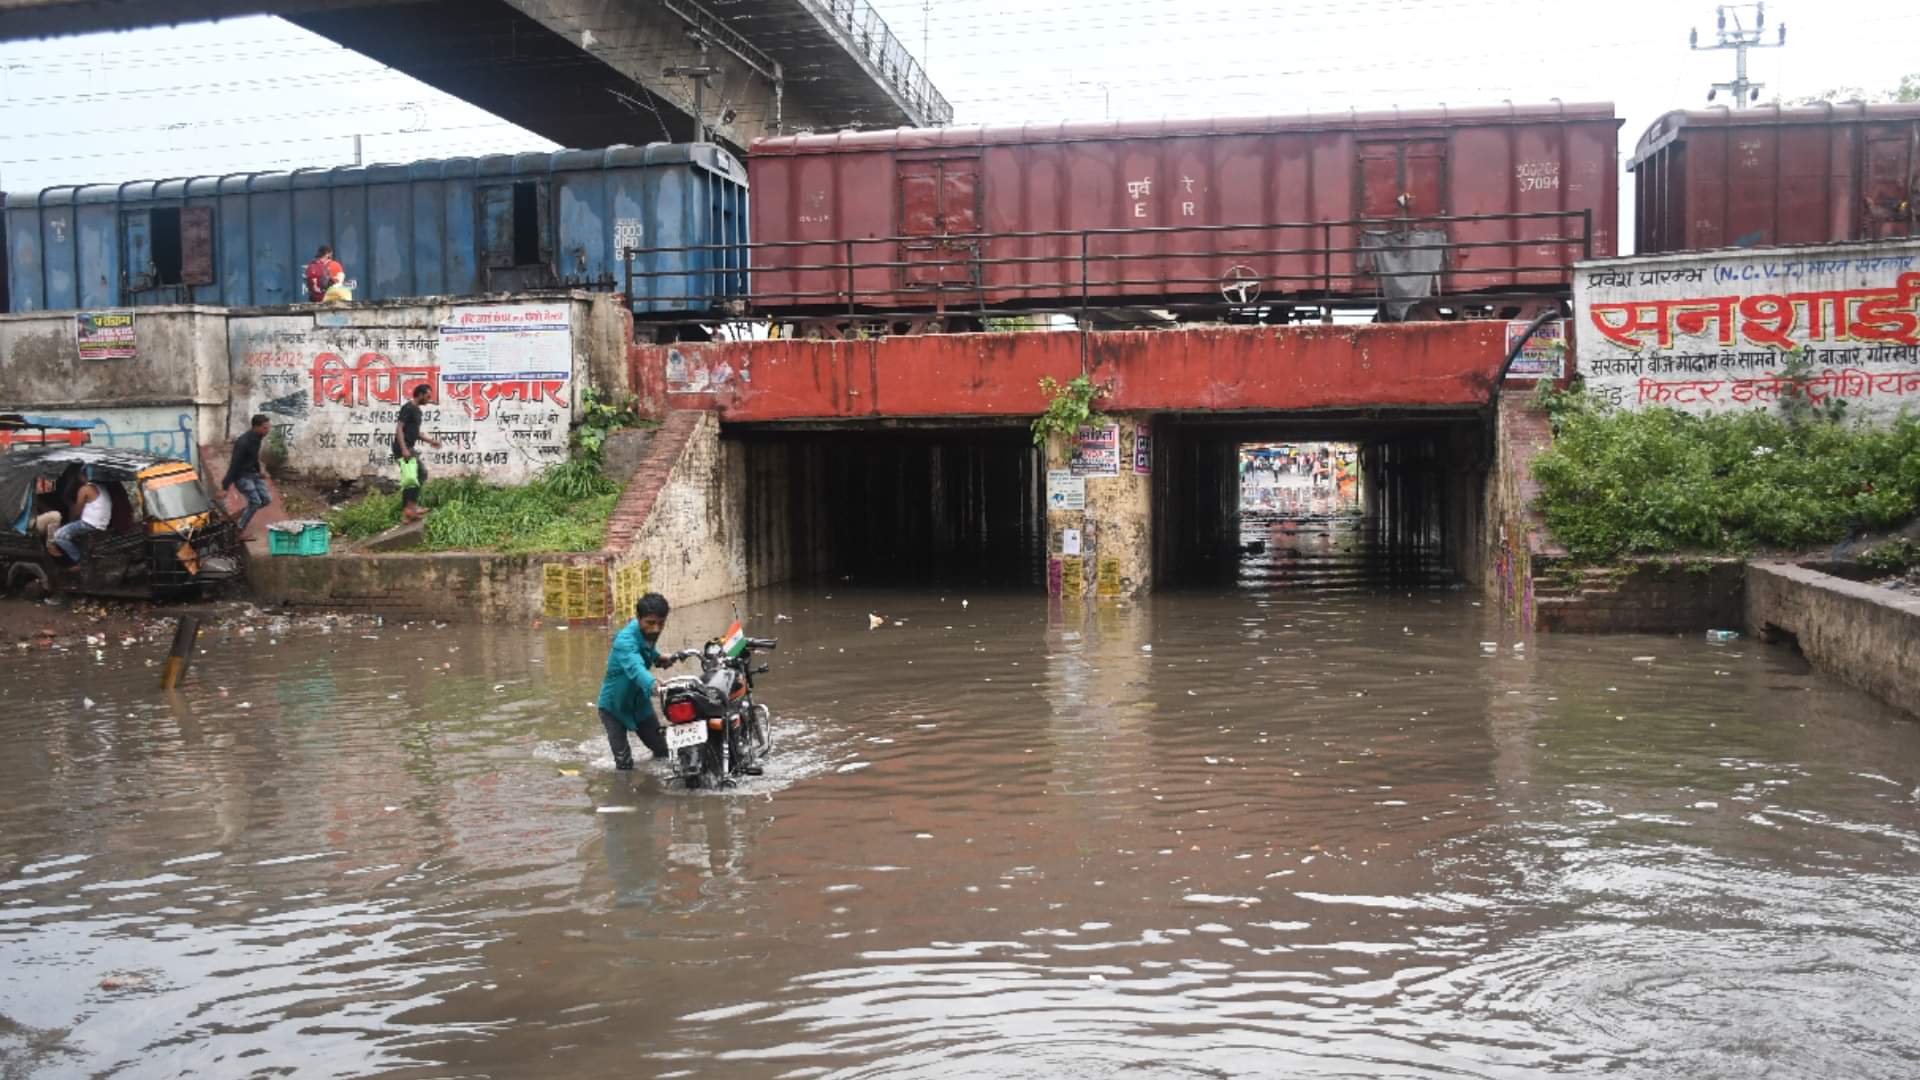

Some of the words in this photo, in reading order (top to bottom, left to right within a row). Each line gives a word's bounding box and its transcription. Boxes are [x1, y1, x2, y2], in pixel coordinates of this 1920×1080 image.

[1134, 202, 1147, 217] E
[1182, 202, 1195, 216] R
[1587, 268, 1634, 290] प्रवेश
[1590, 351, 1644, 377] सरकारी
[1719, 350, 1738, 369] के
